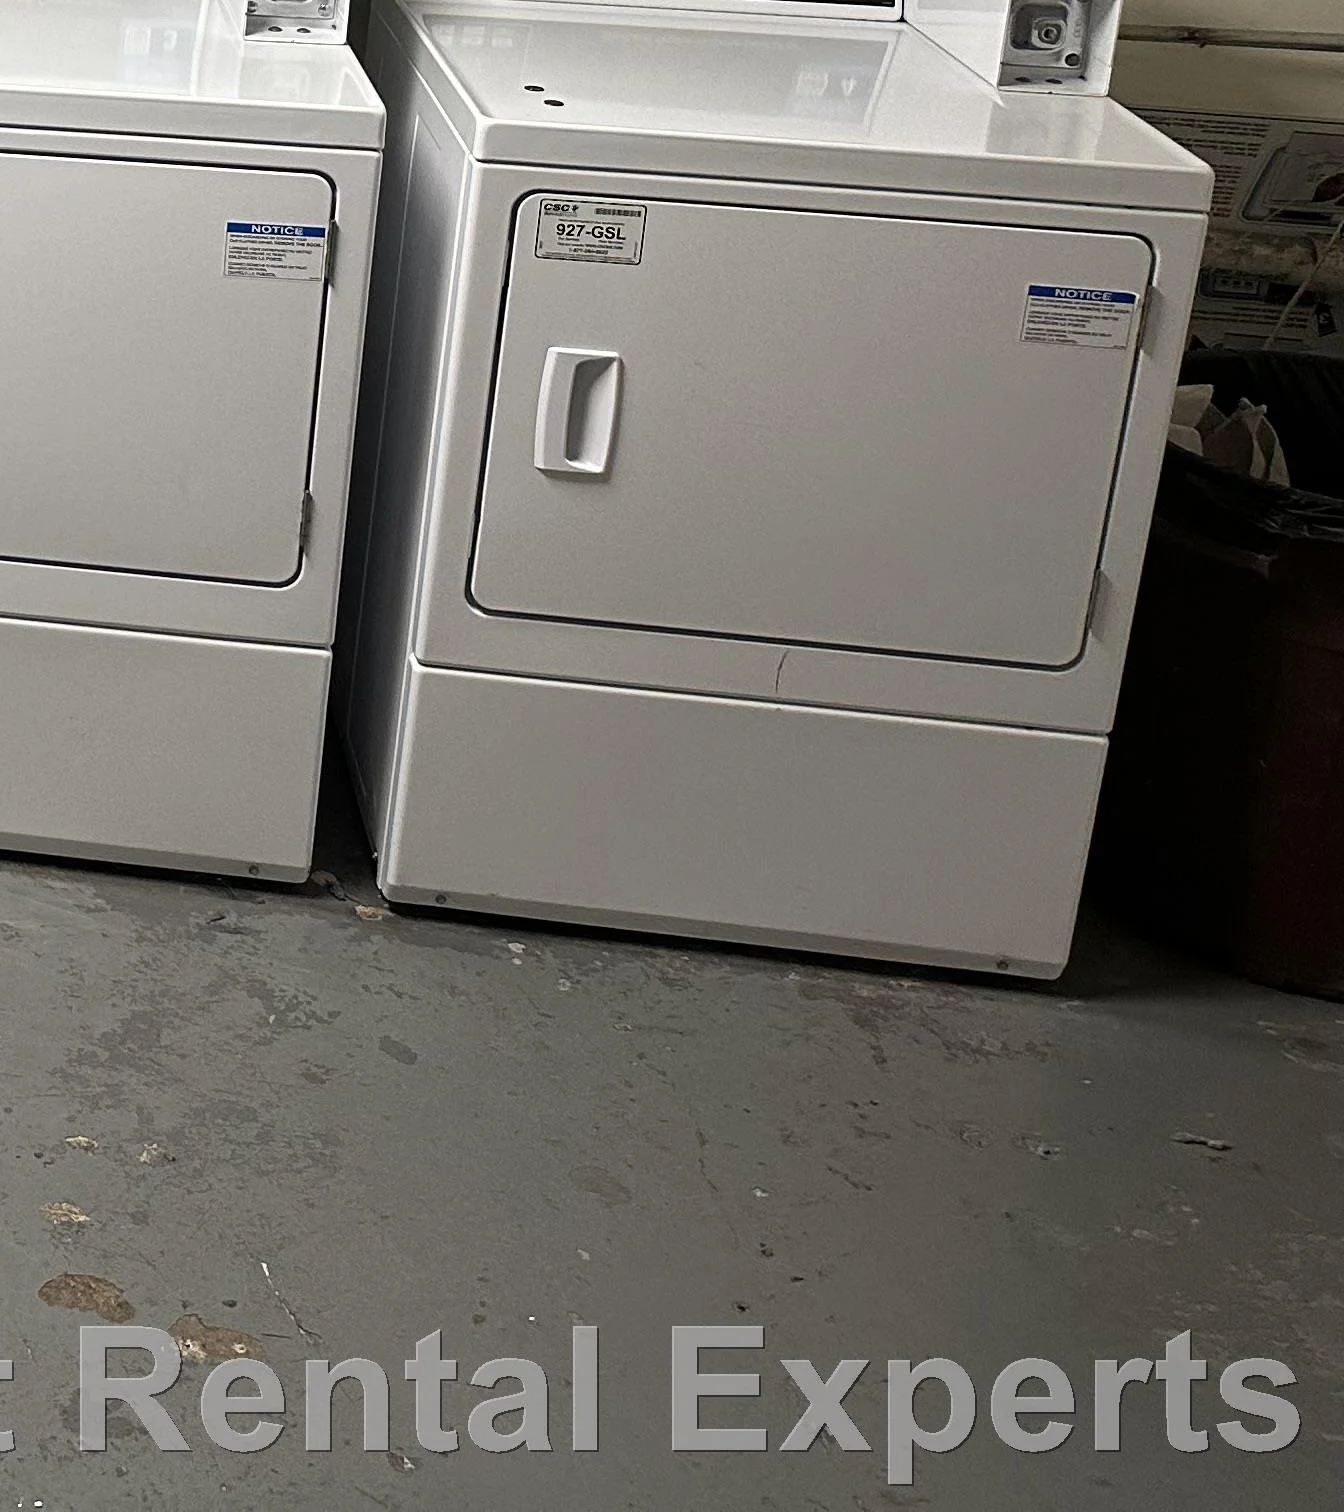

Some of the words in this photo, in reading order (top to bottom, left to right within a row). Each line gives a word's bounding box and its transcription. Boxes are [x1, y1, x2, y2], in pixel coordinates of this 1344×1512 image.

[543, 203, 570, 212] CSC
[251, 224, 304, 235] NOTICE
[556, 223, 627, 241] 927-GSL
[1054, 288, 1113, 301] NOTICE
